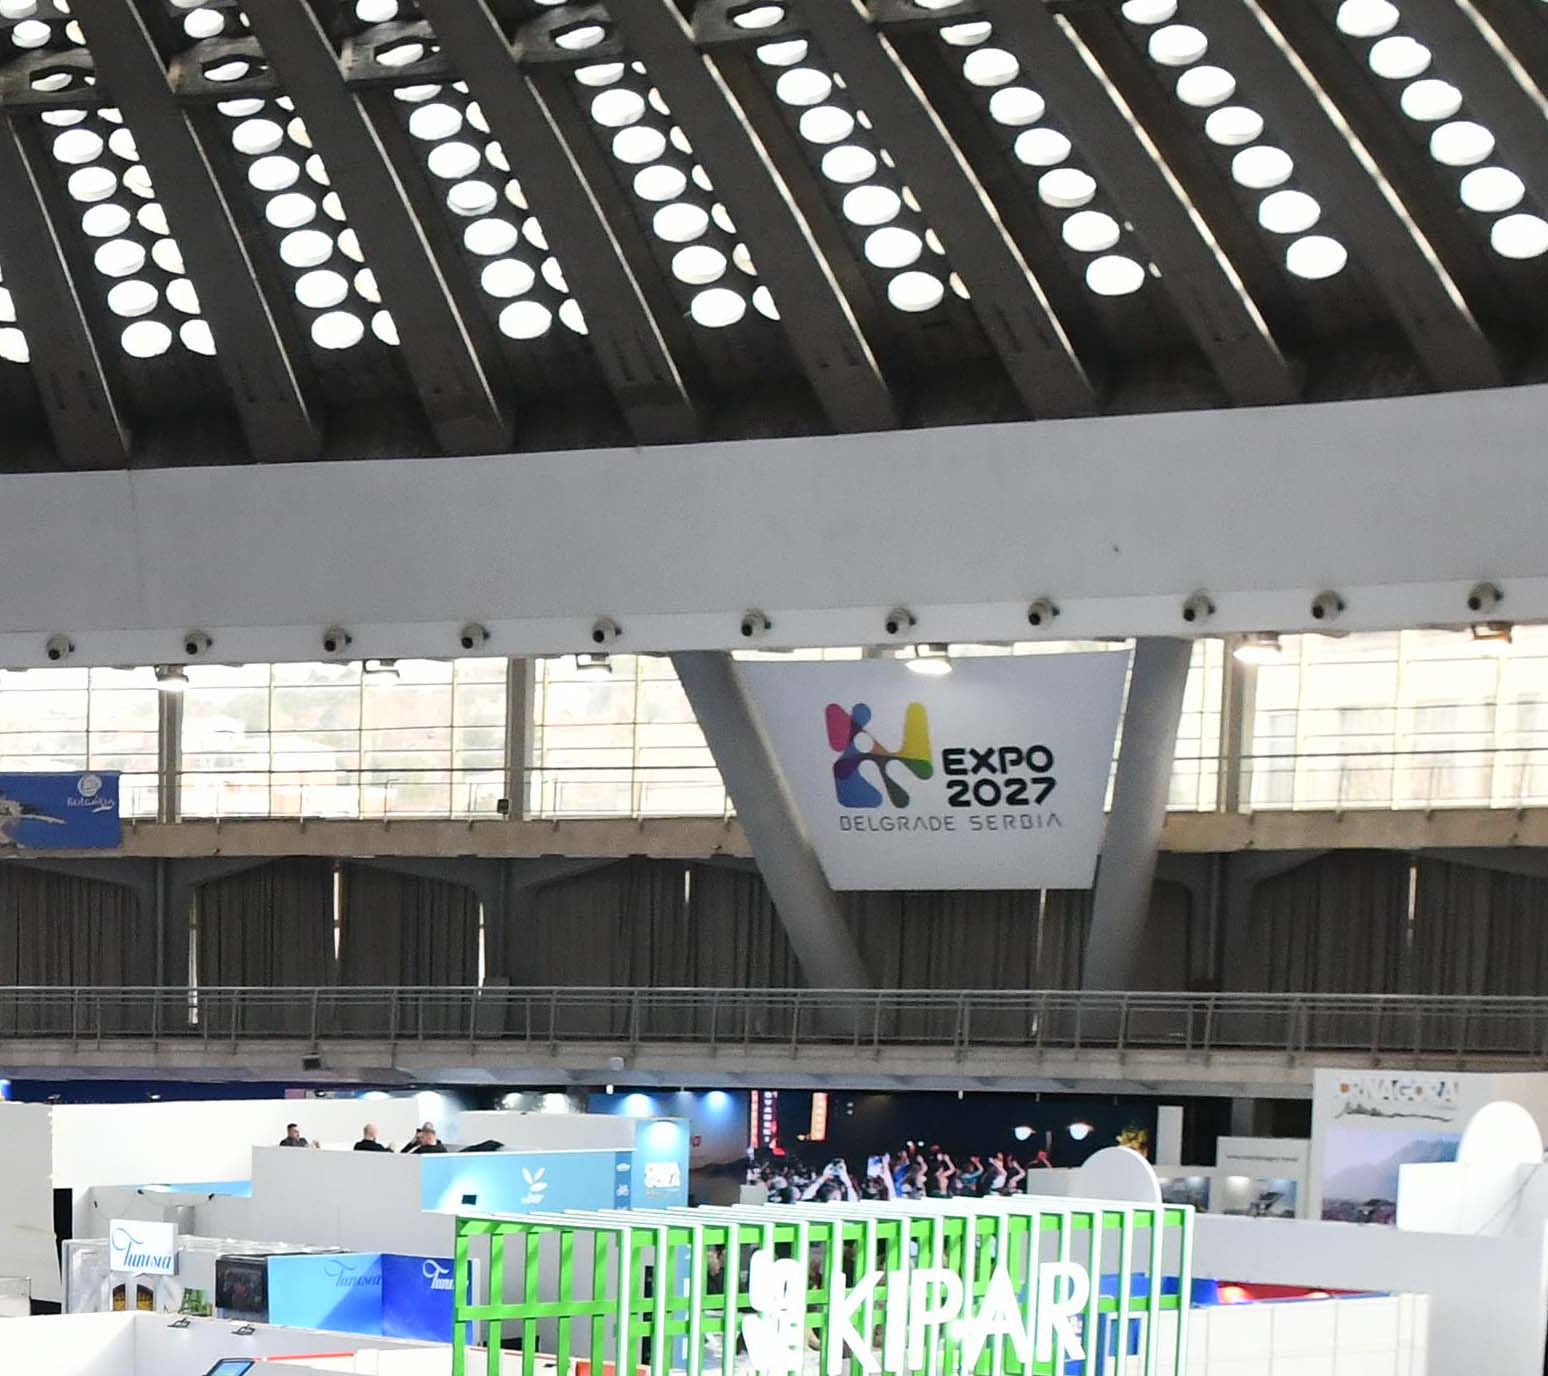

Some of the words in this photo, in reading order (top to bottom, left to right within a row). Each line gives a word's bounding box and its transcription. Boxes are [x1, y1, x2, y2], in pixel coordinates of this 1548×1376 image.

[942, 744, 1054, 776] EXPO
[946, 777, 1056, 807] 2027
[839, 814, 955, 832] BELGRADE
[969, 812, 1063, 831] SERBIA
[111, 1227, 173, 1270] Tunisia
